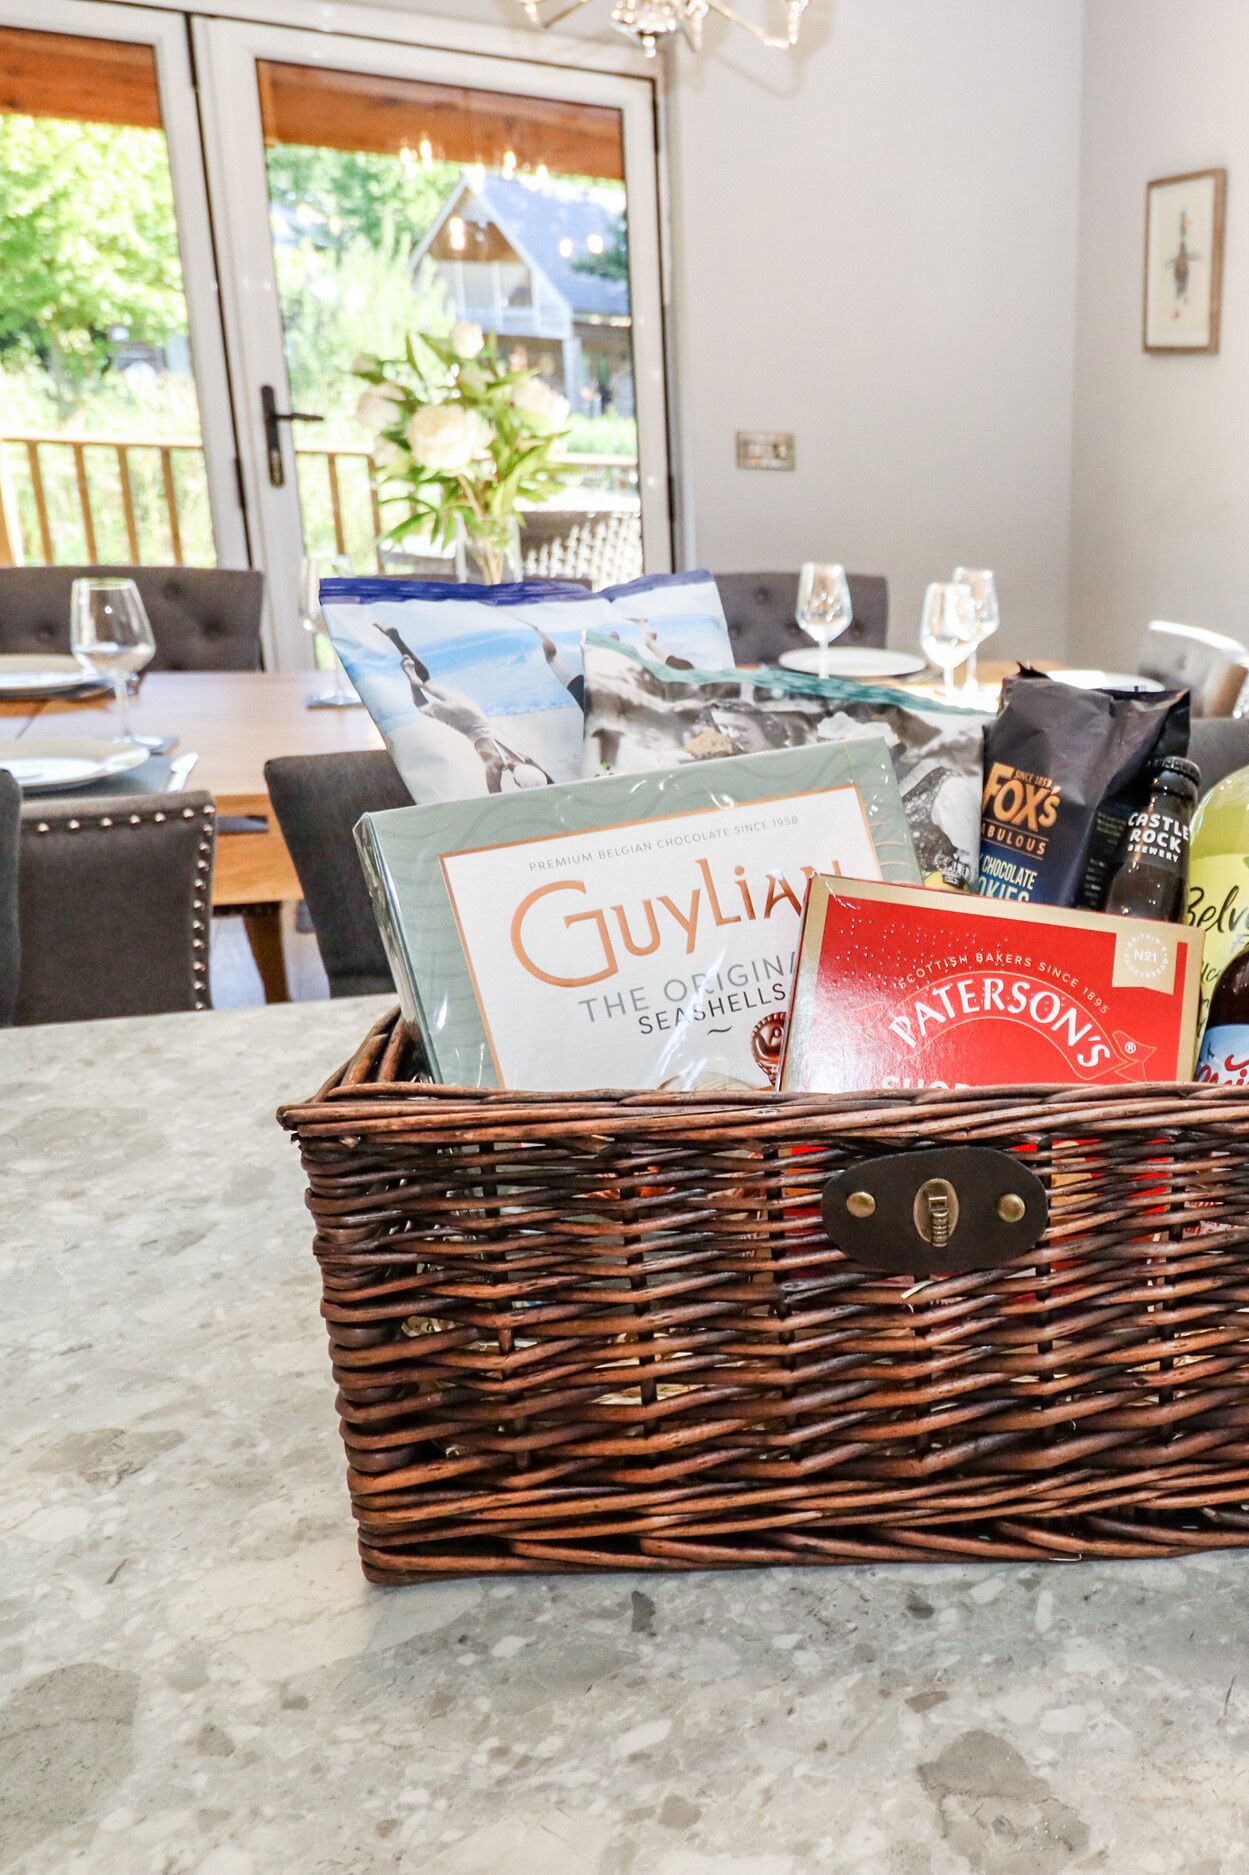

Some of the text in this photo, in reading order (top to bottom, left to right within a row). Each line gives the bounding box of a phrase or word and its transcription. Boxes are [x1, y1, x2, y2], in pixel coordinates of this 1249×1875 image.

[529, 815, 799, 872] PREMIUM BELGIAN CHOCOLATE SINCE 1958
[1128, 812, 1189, 841] CASTLE
[1129, 828, 1182, 854] ROCK
[1128, 844, 1179, 863] BREWERY
[981, 854, 1038, 890] CHOCOLATE
[898, 952, 1110, 1014] SCOTTISH BAKERS SINCE 1895
[578, 987, 650, 1023] THE
[638, 983, 786, 1035] SEASHELLS
[888, 977, 1111, 1068] PATERSON'S
